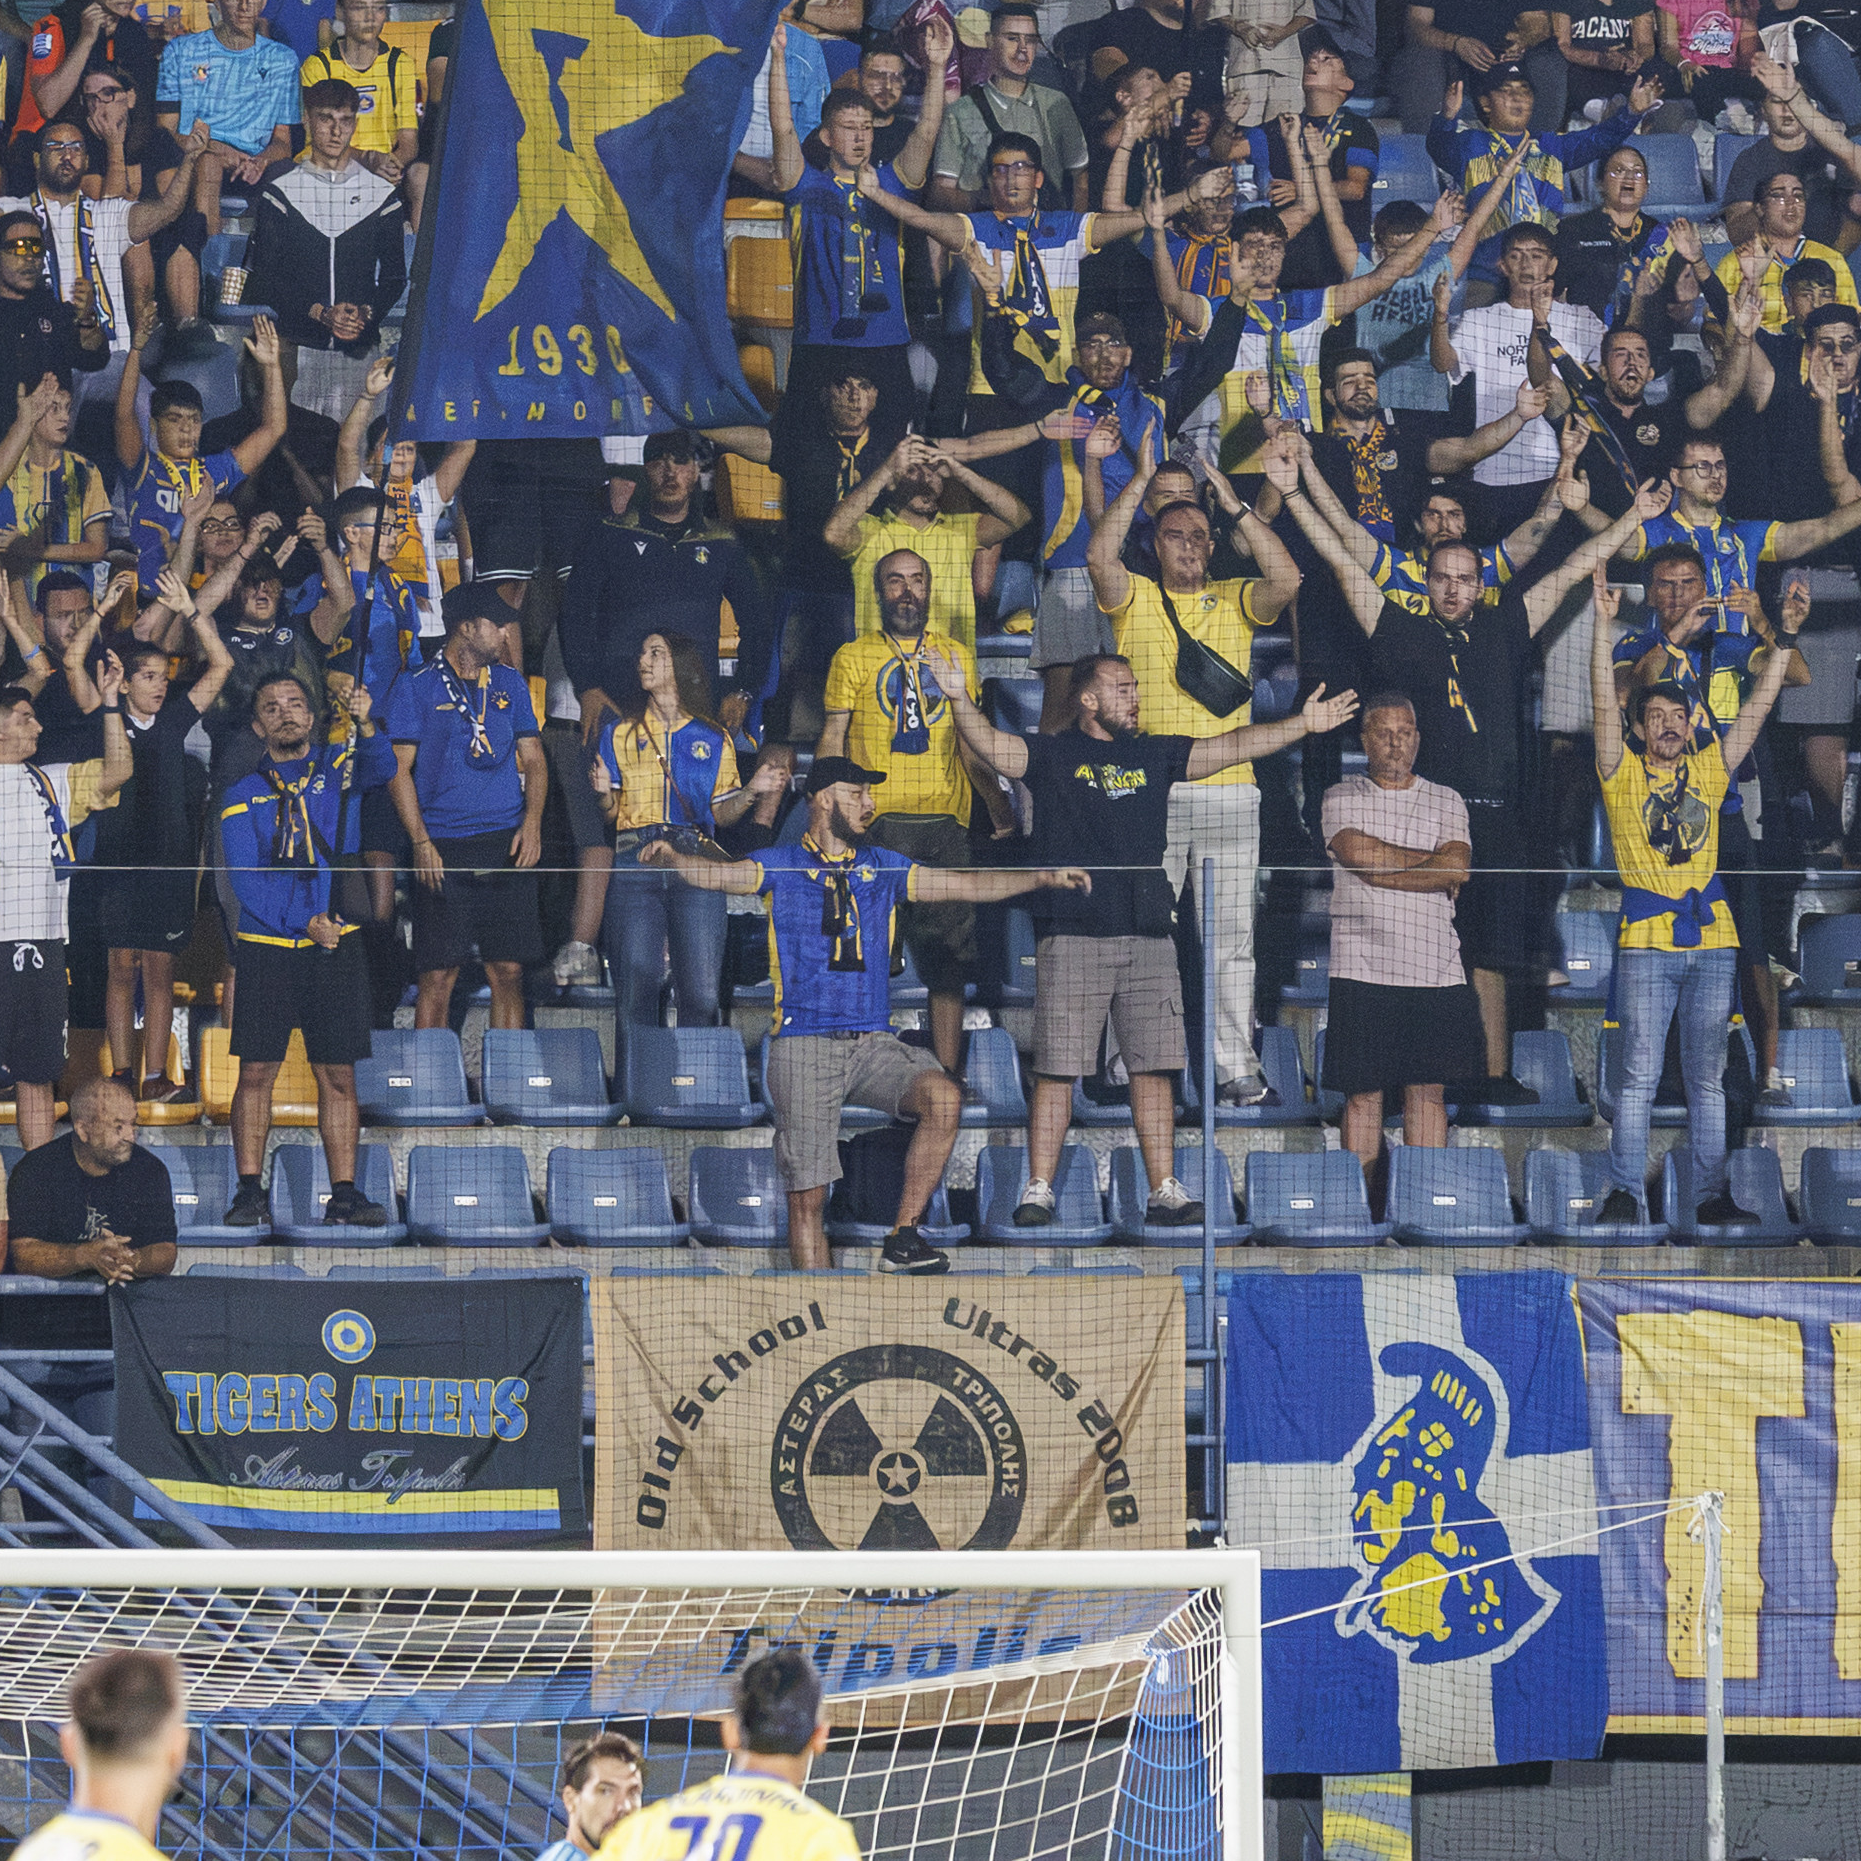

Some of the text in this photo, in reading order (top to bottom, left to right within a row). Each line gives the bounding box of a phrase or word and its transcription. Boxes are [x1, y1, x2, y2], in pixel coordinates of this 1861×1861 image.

[161, 1369, 530, 1443] TIGERS ATHENS
[636, 1434, 686, 1531] Old
[676, 1300, 829, 1432] School
[942, 1296, 1083, 1403] Ultras
[777, 1366, 1021, 1499] ΑΣΤΕΡΑΣ ΤΡΙΠΟΛΗΣ
[720, 1626, 1084, 1695] Tipoli
